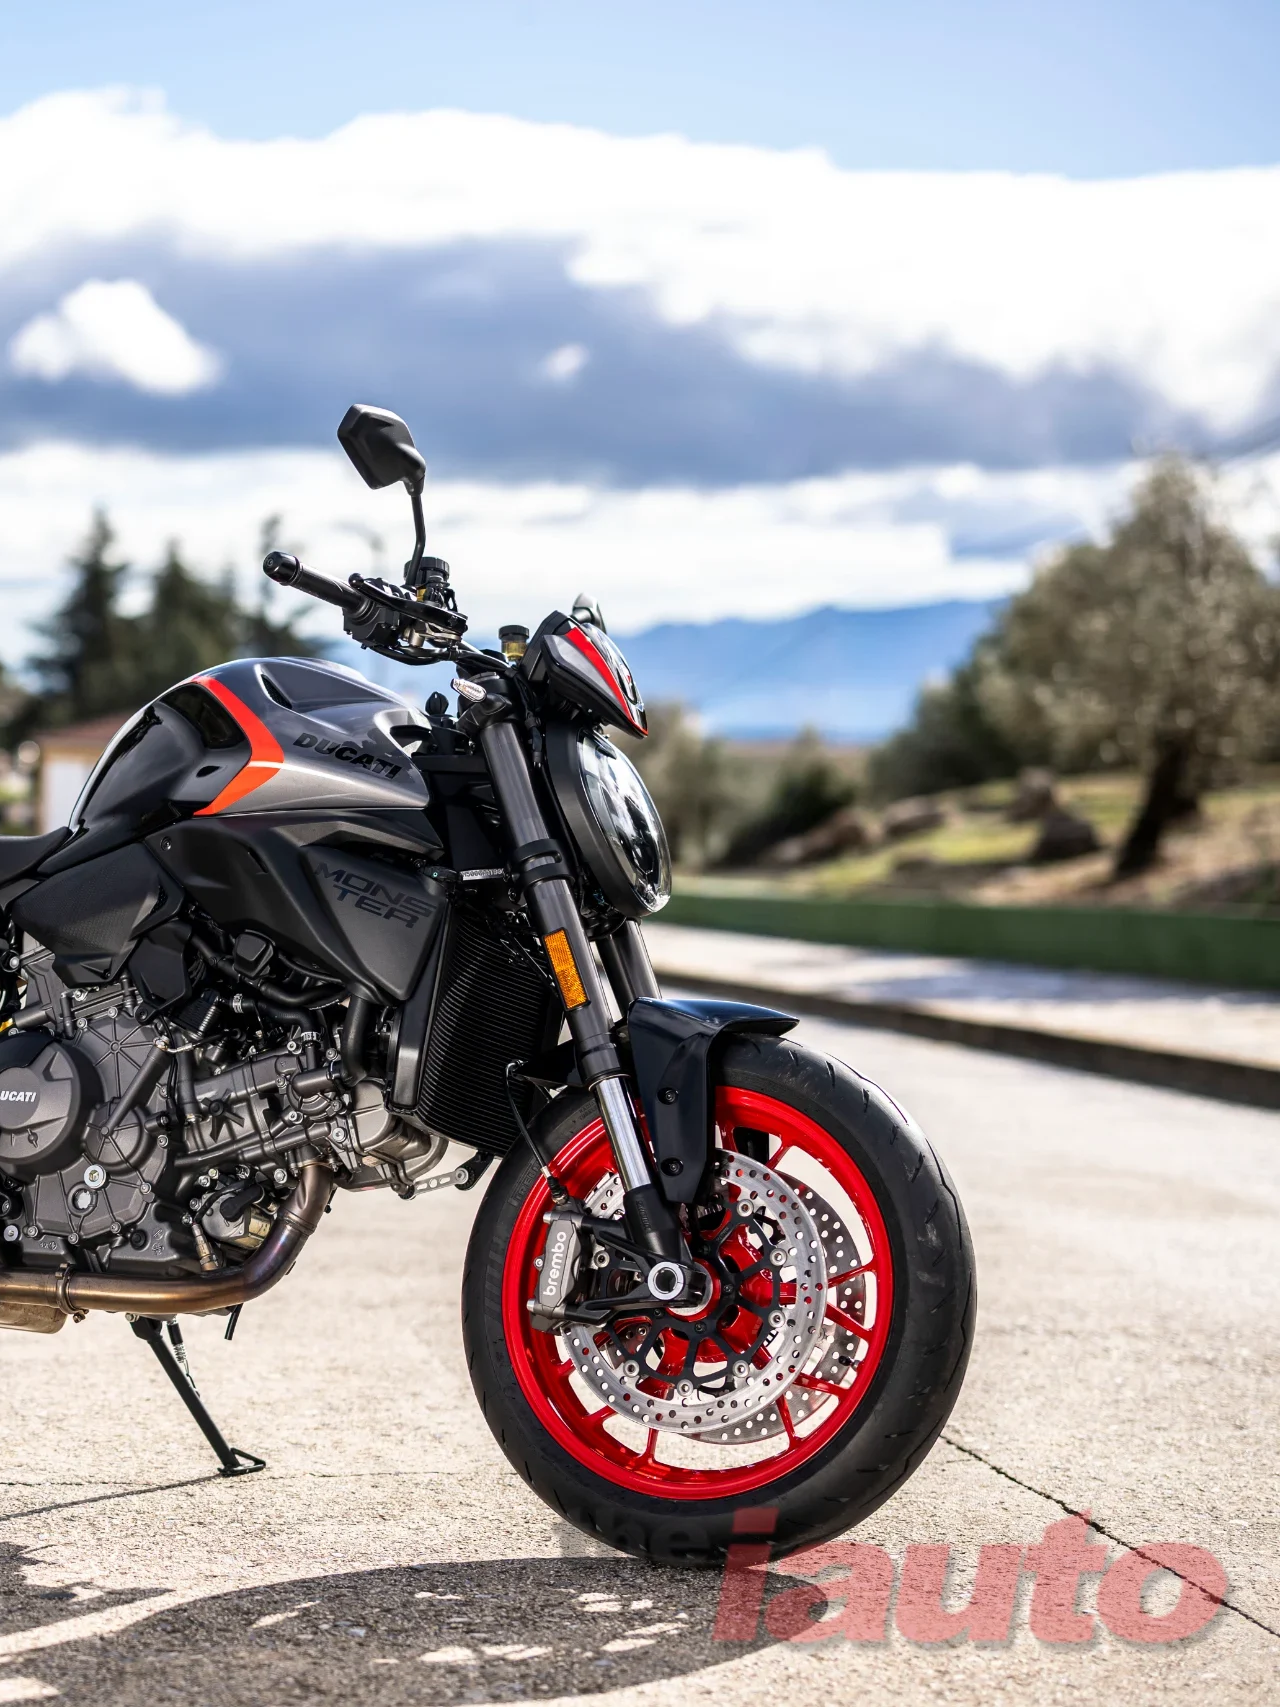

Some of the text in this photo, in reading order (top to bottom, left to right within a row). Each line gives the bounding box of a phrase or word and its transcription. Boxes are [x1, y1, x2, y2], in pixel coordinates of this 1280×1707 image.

[293, 732, 402, 779] DUCATI
[315, 862, 437, 918] MONS
[333, 884, 420, 928] TER
[543, 1231, 567, 1296] brembo
